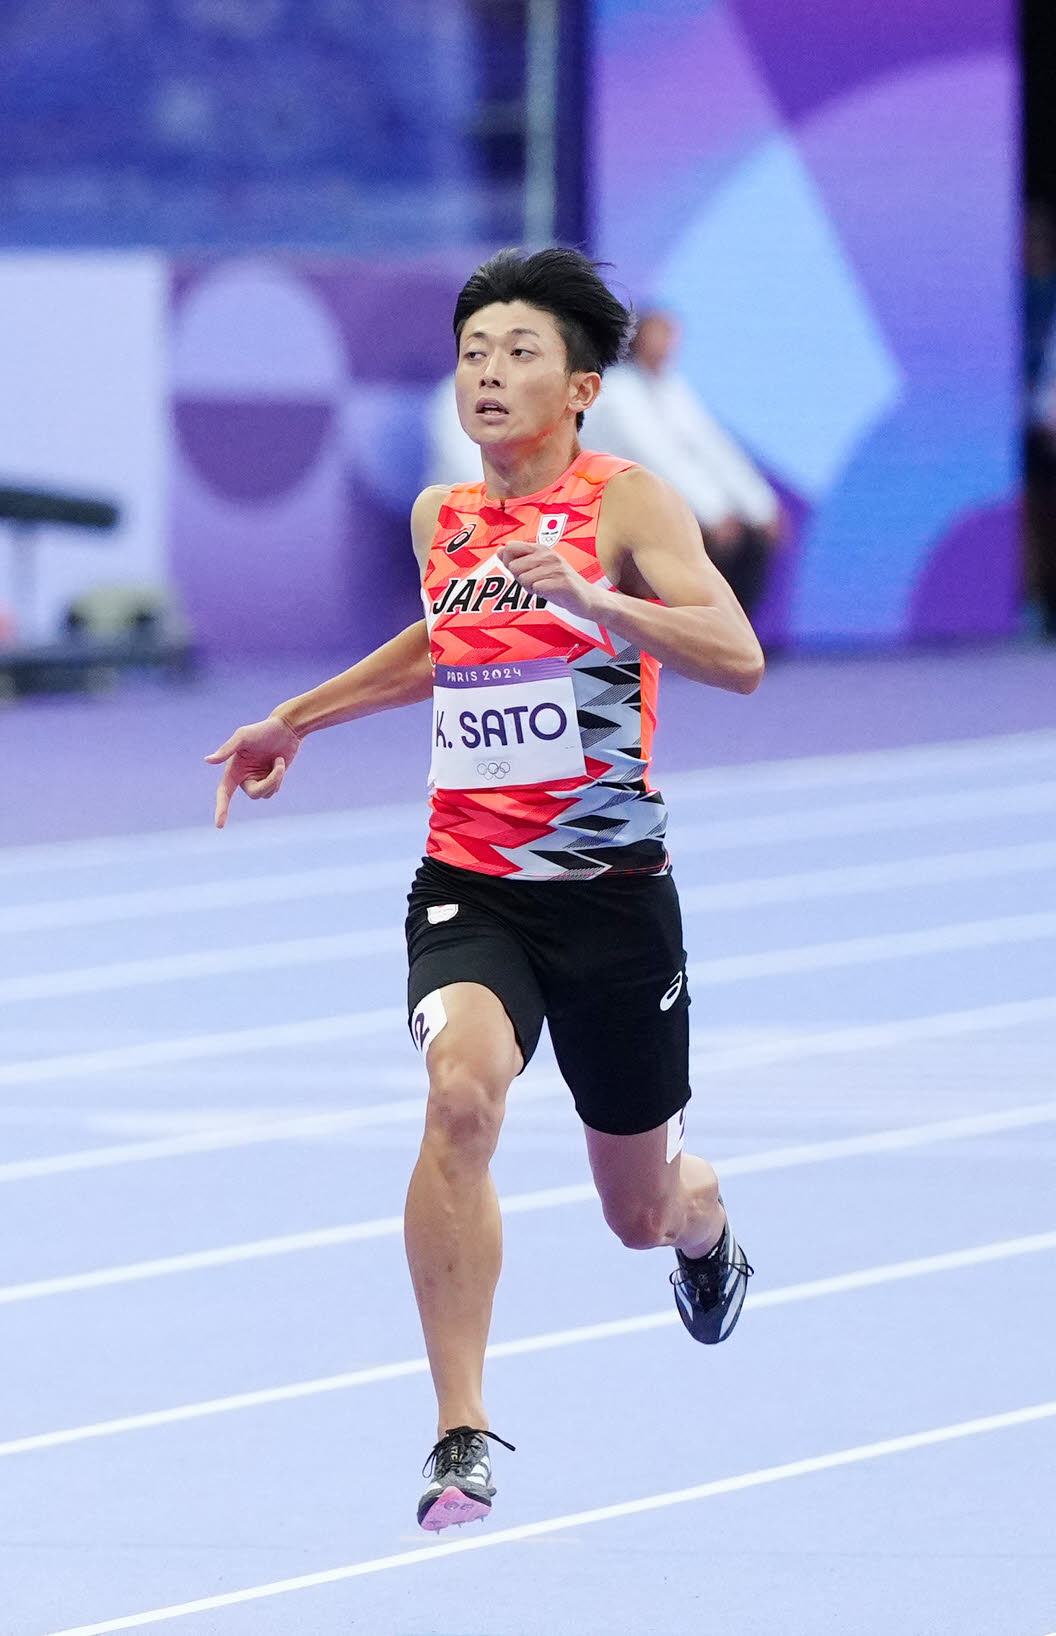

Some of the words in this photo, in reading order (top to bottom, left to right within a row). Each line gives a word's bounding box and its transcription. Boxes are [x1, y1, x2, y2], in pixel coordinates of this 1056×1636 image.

[447, 671, 478, 683] PARIS
[483, 667, 521, 681] 2024
[436, 710, 453, 749] K.
[459, 702, 567, 749] SATO
